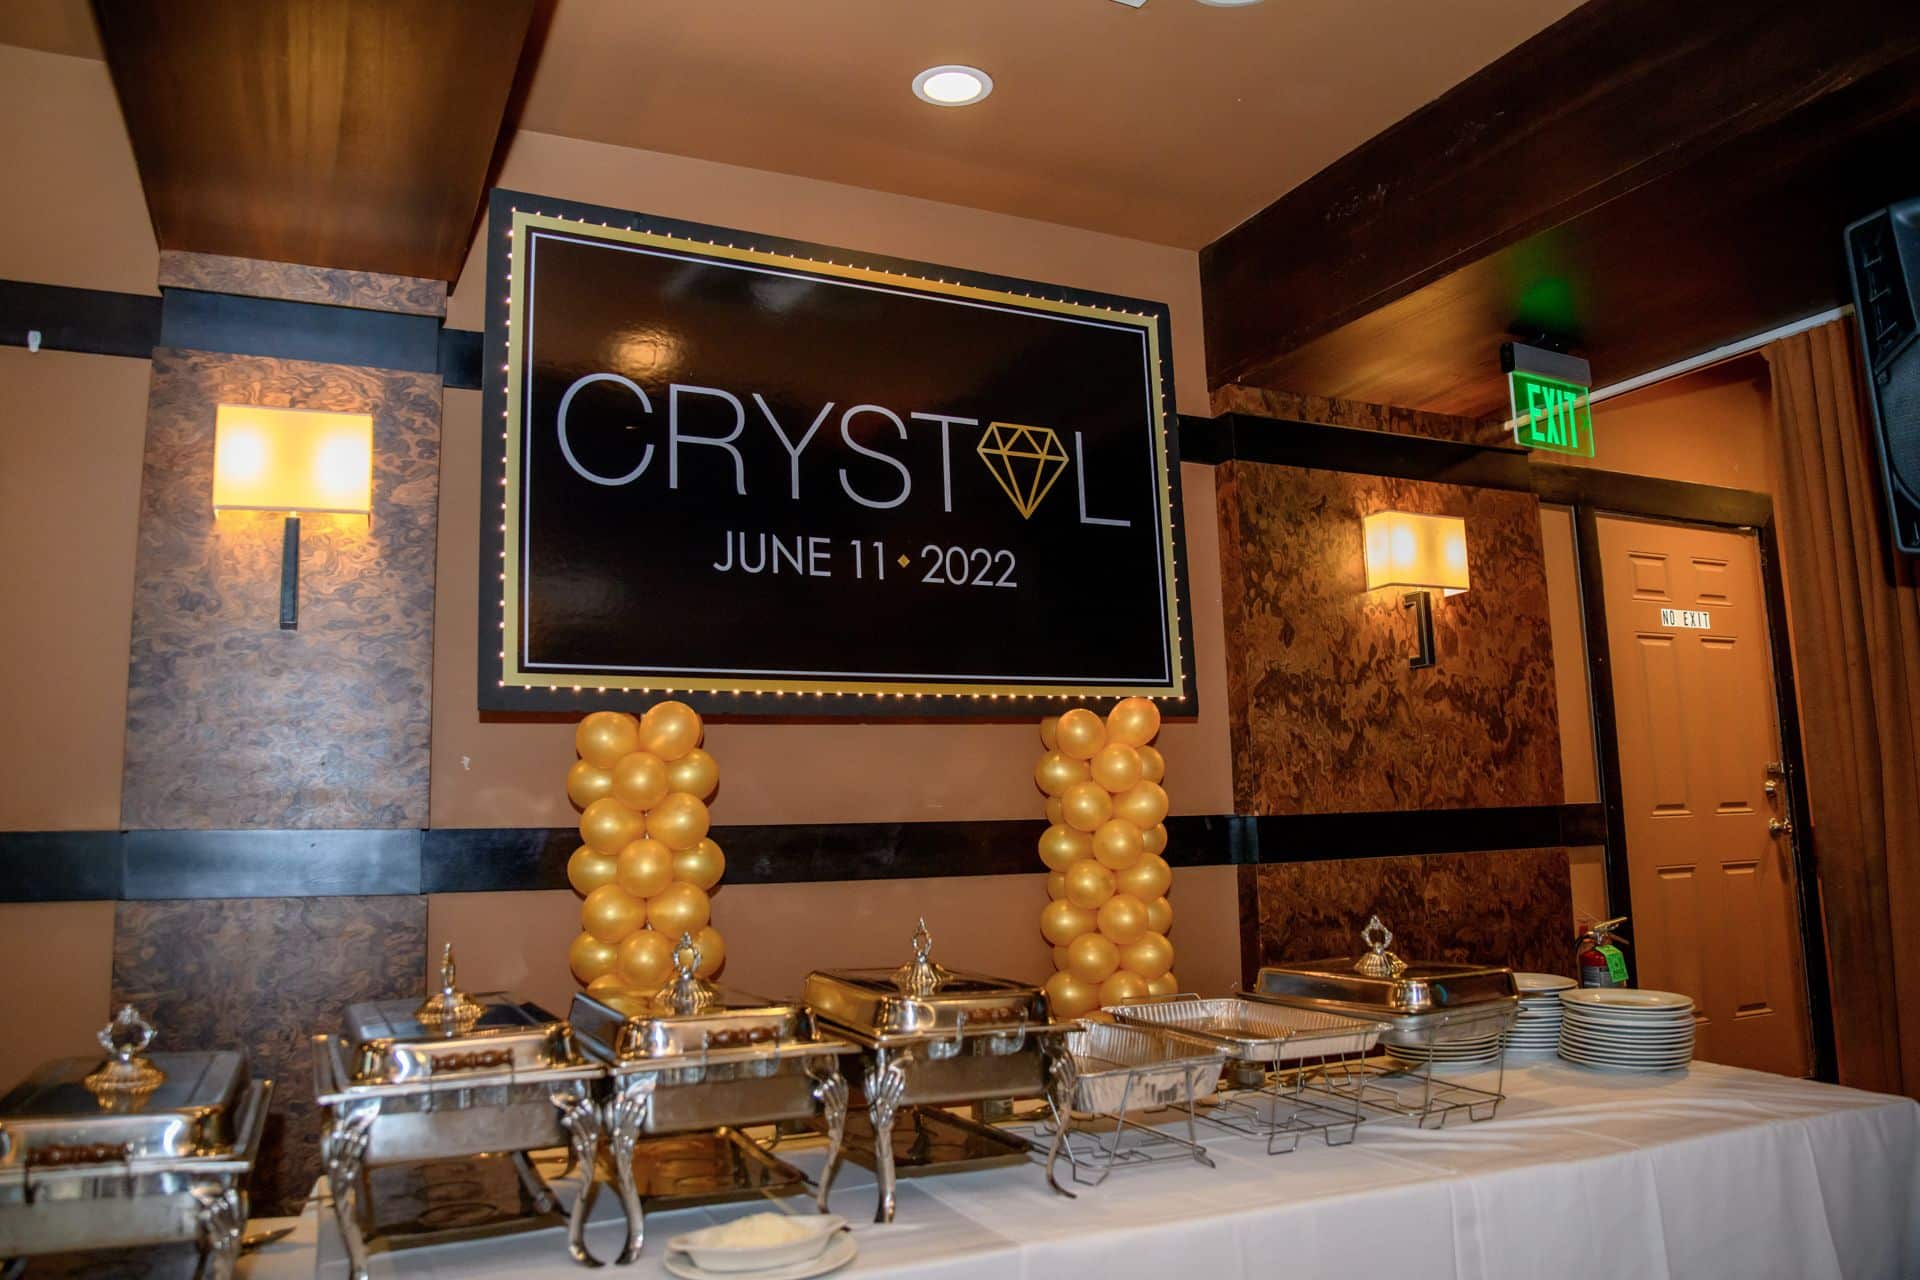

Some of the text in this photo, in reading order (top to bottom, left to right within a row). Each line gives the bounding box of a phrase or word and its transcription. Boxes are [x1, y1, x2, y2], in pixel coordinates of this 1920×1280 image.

[1527, 383, 1578, 449] EXIT
[557, 373, 1131, 528] CRYSTL
[713, 530, 1018, 588] JUNE 11 2022
[1662, 610, 1708, 627] NO EXIT
